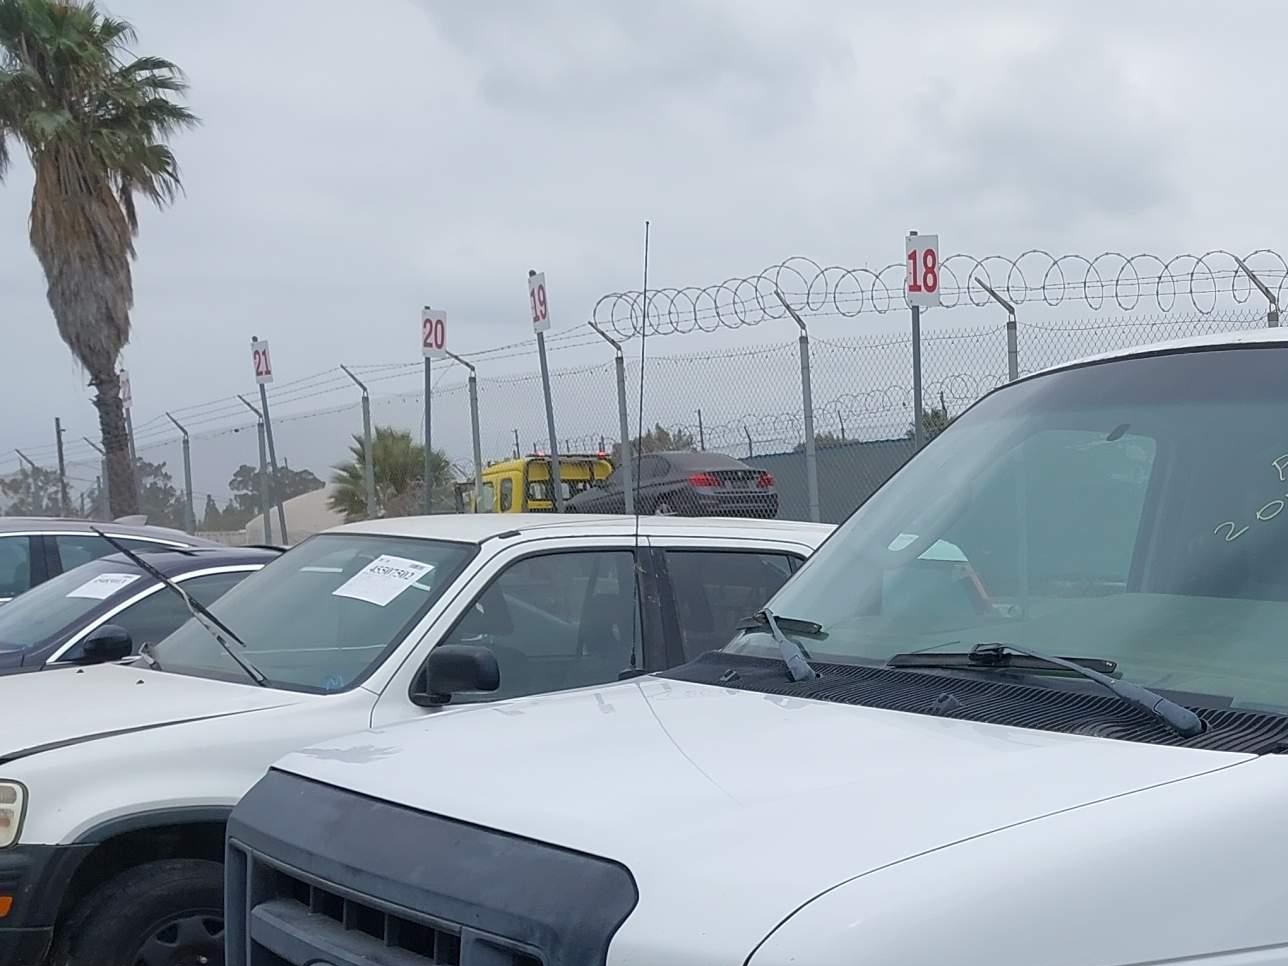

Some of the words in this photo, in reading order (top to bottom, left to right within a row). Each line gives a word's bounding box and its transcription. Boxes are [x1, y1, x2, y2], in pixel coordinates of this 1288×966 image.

[908, 248, 938, 293] 18
[530, 283, 546, 322] 19
[423, 318, 445, 349] 20
[253, 349, 272, 376] 21
